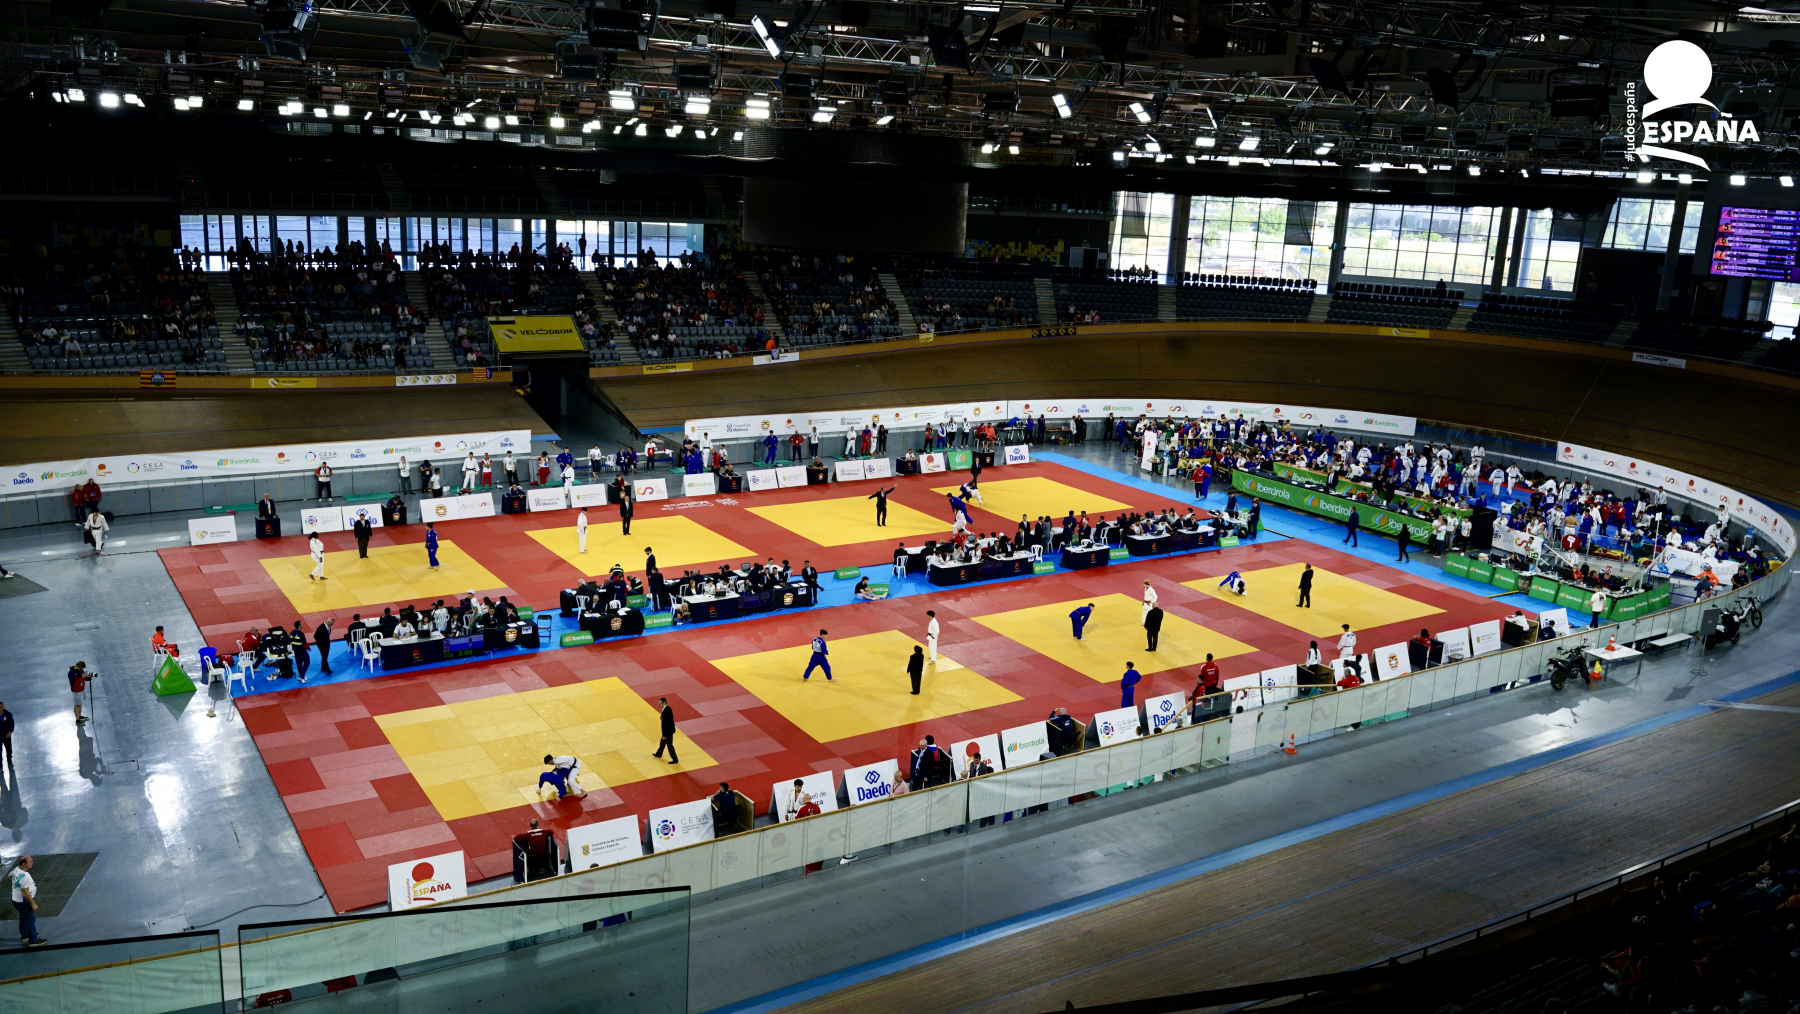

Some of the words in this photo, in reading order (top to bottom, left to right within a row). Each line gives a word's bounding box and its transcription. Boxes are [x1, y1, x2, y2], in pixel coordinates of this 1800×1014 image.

[1373, 420, 1399, 428] Iberdrola
[394, 446, 421, 454] Iberdrola
[229, 457, 259, 465] Iberdrola
[1009, 454, 1026, 462] Daedo
[54, 469, 87, 479] Iberdrola
[13, 477, 34, 485] Daedo
[1256, 482, 1291, 500] Iberdrola
[1319, 499, 1351, 516] Iberdrol
[349, 516, 378, 527] Ddo
[651, 617, 672, 625] Iberdrola
[572, 633, 592, 642] Iberdrola
[1278, 675, 1295, 684] CESA
[1116, 717, 1138, 727] CESA
[1153, 708, 1176, 728] Daed
[1018, 737, 1045, 750] Iberdrola
[856, 782, 891, 802] Daedo
[680, 814, 709, 825] CESA
[412, 881, 452, 898] ESPAÑA
